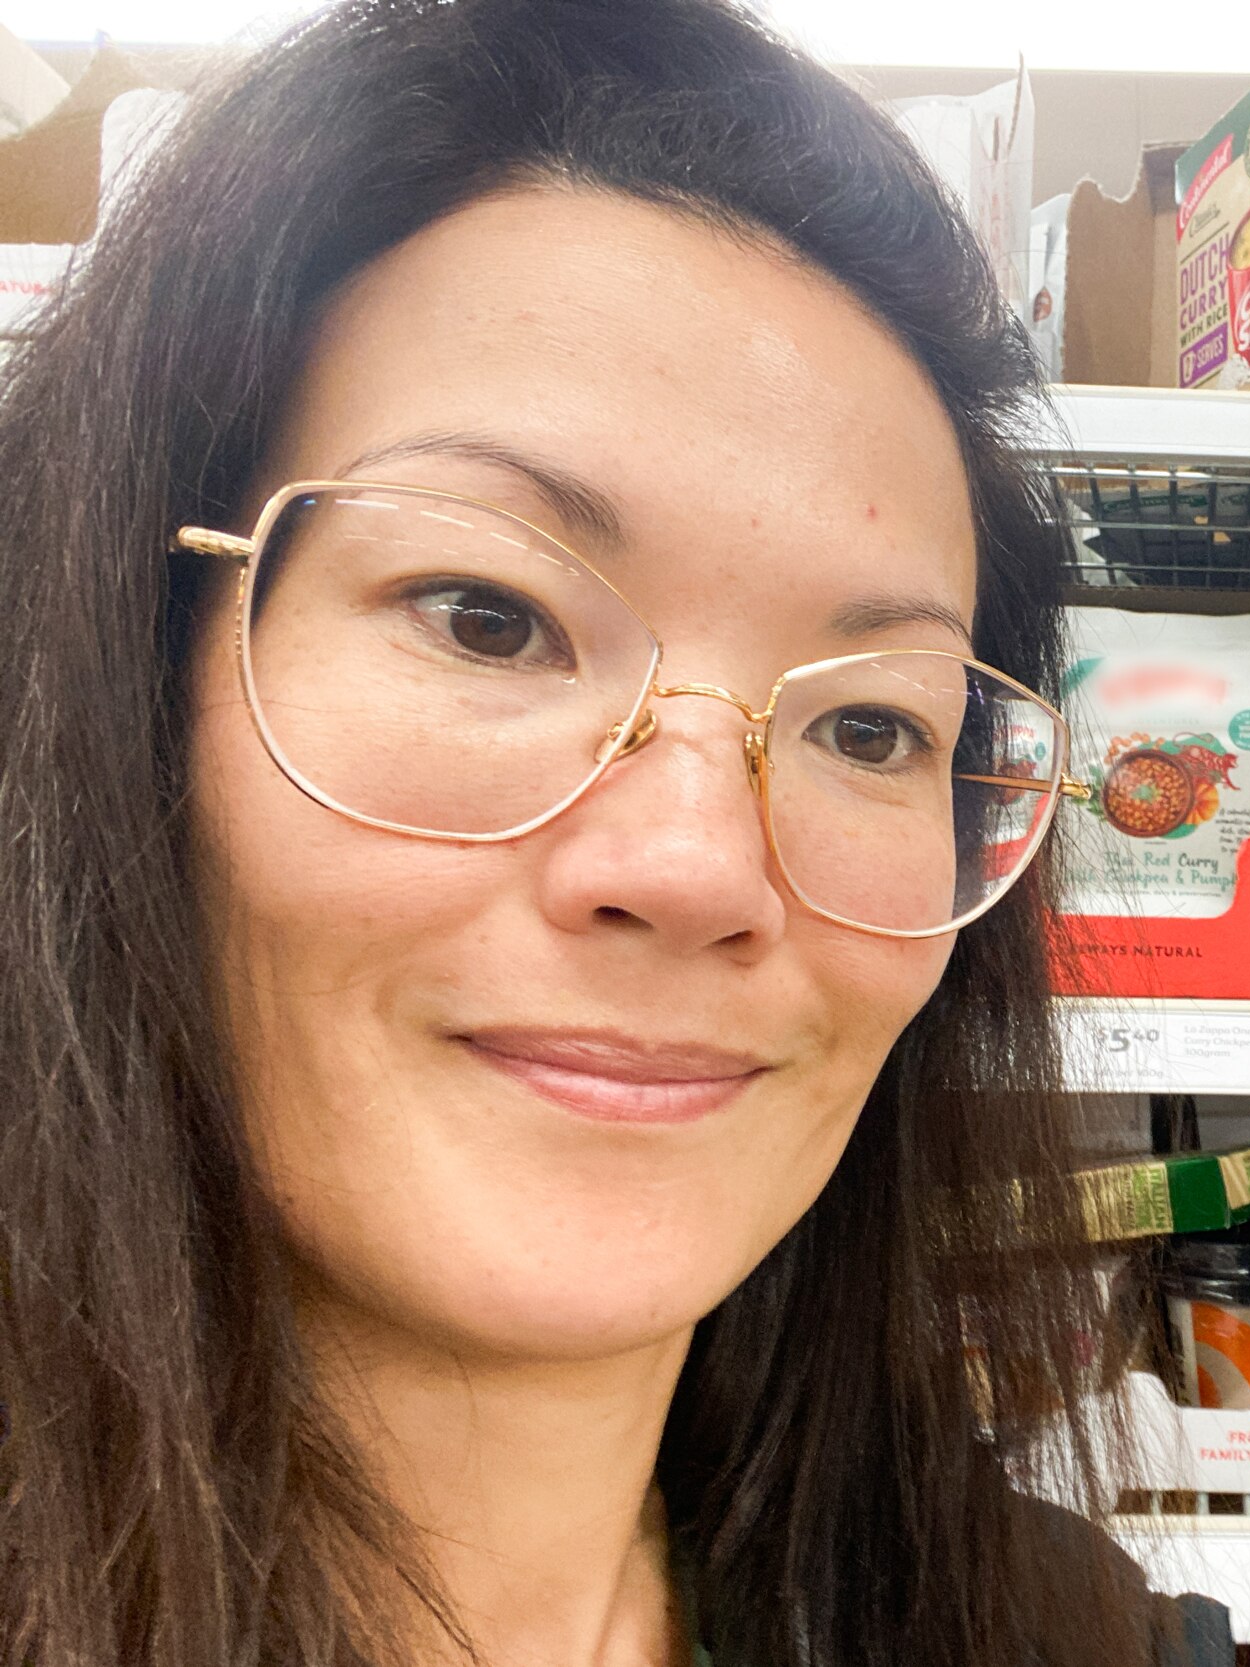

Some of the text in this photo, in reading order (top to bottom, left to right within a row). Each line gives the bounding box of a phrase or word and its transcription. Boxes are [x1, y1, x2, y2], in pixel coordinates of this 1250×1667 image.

[1180, 233, 1230, 305] DUTCH
[1180, 275, 1228, 330] CURRY
[1180, 303, 1228, 347] WITH RICE
[1144, 851, 1170, 867] Red
[1178, 852, 1218, 874] Curry
[1175, 869, 1185, 885] &
[1133, 944, 1203, 957] NATURAL
[1184, 1037, 1211, 1048] Curry
